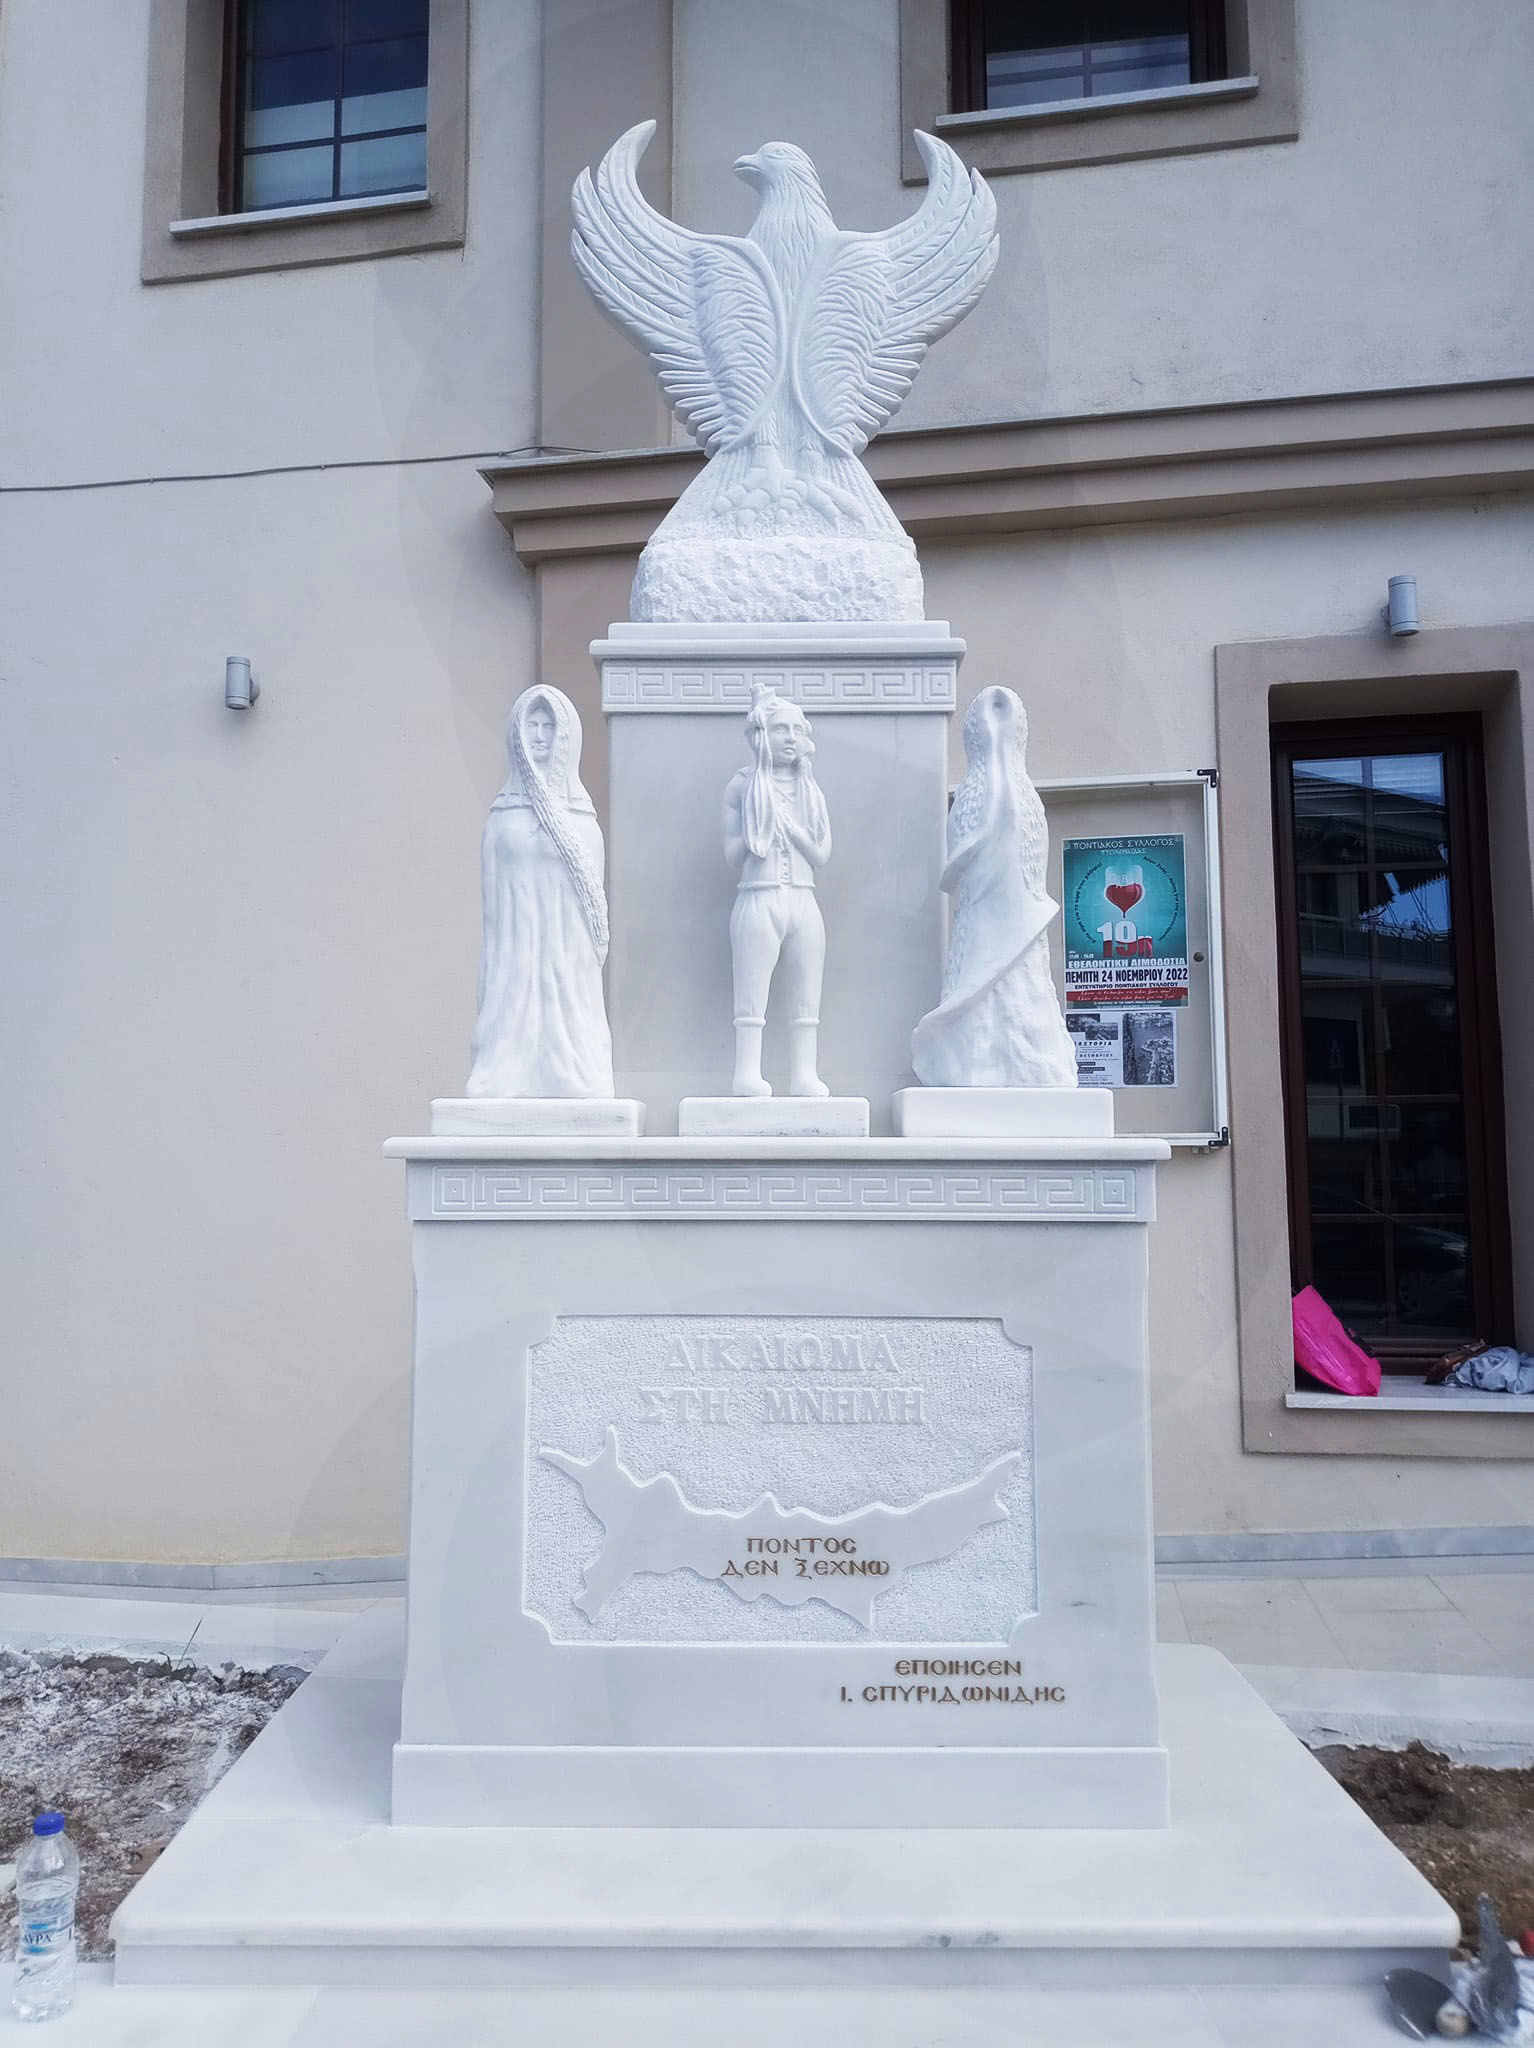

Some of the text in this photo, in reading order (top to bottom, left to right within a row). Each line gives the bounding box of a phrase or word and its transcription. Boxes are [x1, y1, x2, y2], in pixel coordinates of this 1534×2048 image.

[1073, 838, 1175, 850] ΠΟΝΤΙΑΚΟΣ ΣΥΛΛΟΓΟΣ
[1068, 957, 1186, 969] ΕΘΕΛΟΝΤΙΚΗ ΑΙΜΟΔΟΣΙΑ
[1065, 967, 1188, 983] ΠΕΜΠΤΗ 24 ΝΟΕΜΒΡΙΟΥ 2022
[663, 1335, 902, 1373] ΔΙΚΑΙΩΜΑ
[637, 1385, 924, 1425] ΣΤΗ ΜΝΗΜΗ
[721, 1560, 779, 1578] ΔΕΝ
